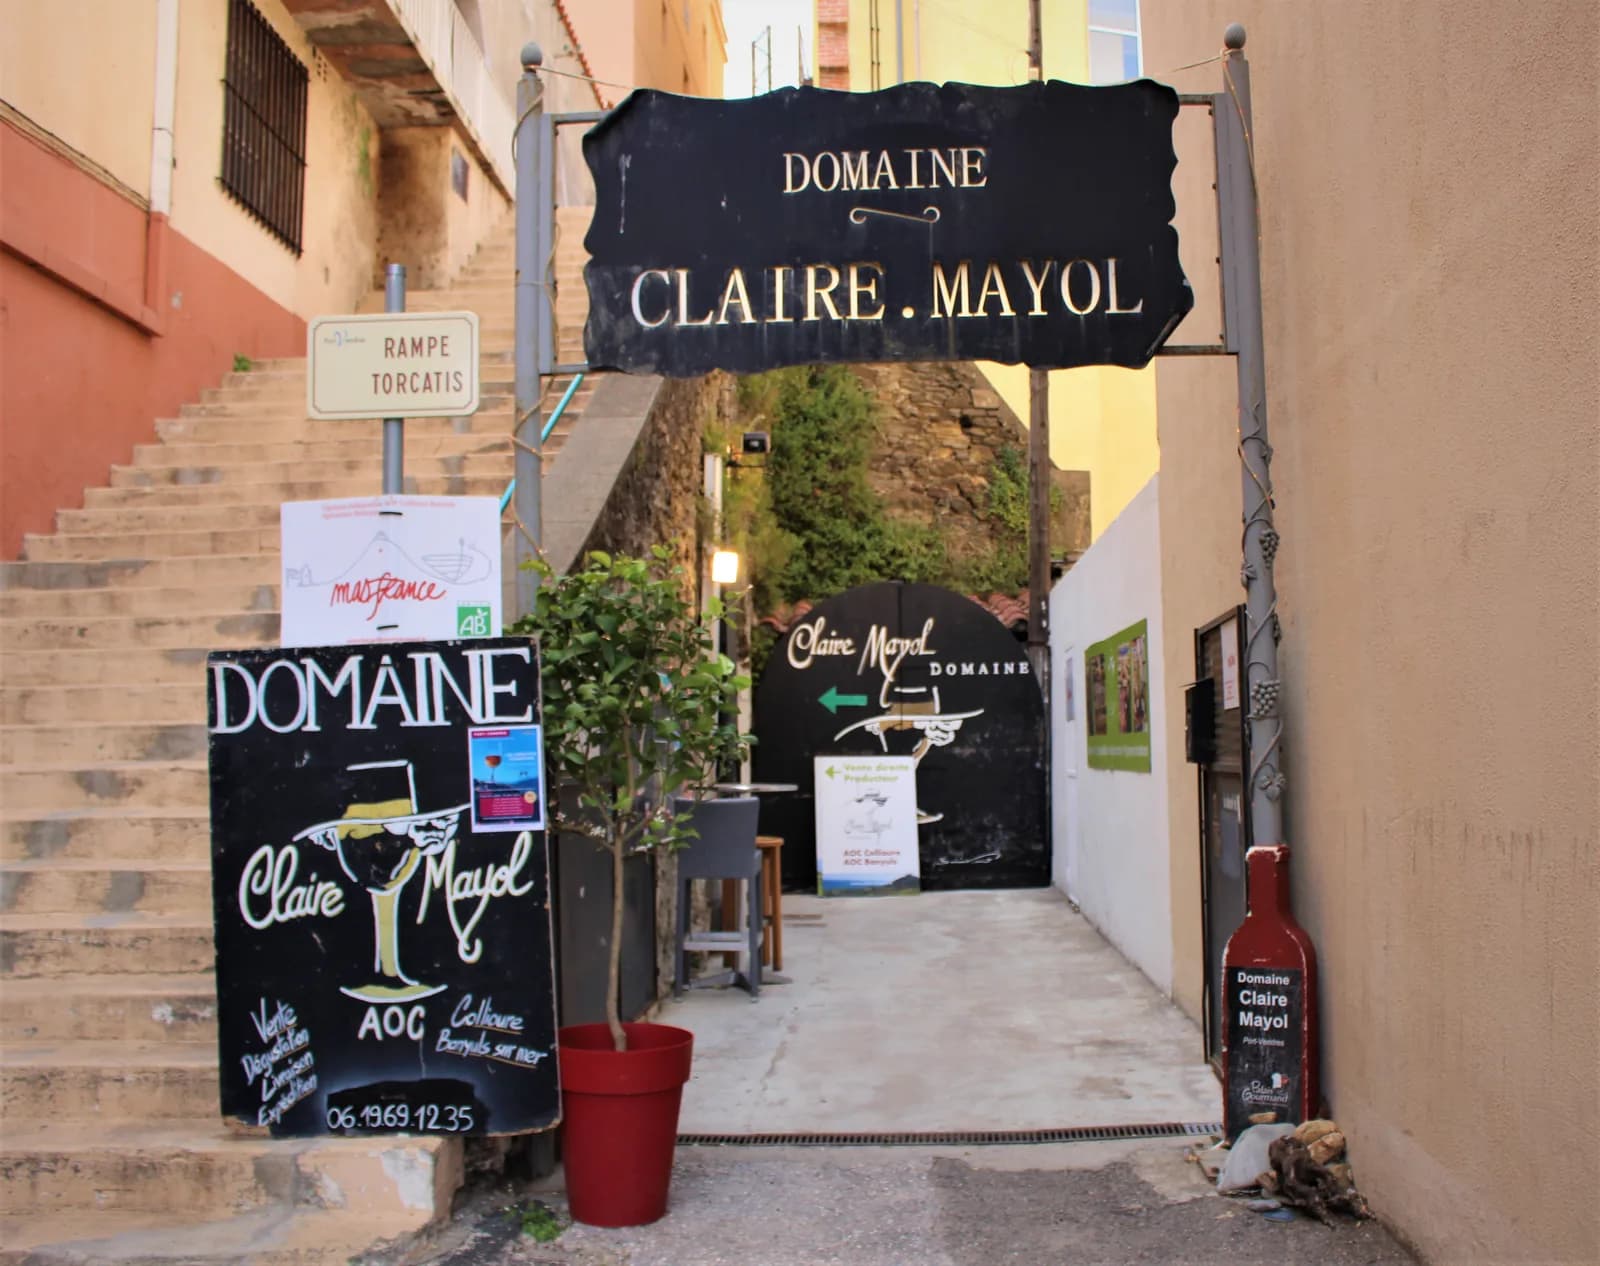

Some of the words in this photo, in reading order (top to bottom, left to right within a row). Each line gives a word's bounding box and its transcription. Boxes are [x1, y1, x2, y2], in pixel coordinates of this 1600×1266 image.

[783, 147, 988, 194] DOMAINE
[630, 263, 885, 329] CLAIRE
[930, 258, 1143, 319] MAYOL
[384, 335, 449, 358] RAMPE
[371, 371, 463, 395] TORCATIS
[459, 614, 487, 636] AB
[787, 616, 856, 670] Claire
[857, 617, 937, 706] Mayol
[929, 661, 1030, 676] DOMAINE
[210, 647, 533, 735] DOMAINE
[239, 845, 345, 929] Claire
[417, 831, 533, 963] Mayol
[1237, 971, 1290, 986] Domaine
[450, 993, 525, 1031] Collioure
[1239, 989, 1288, 1007] Claire
[249, 997, 298, 1044] Vente
[358, 1005, 426, 1041] AOC
[1239, 1011, 1288, 1032] Mayol
